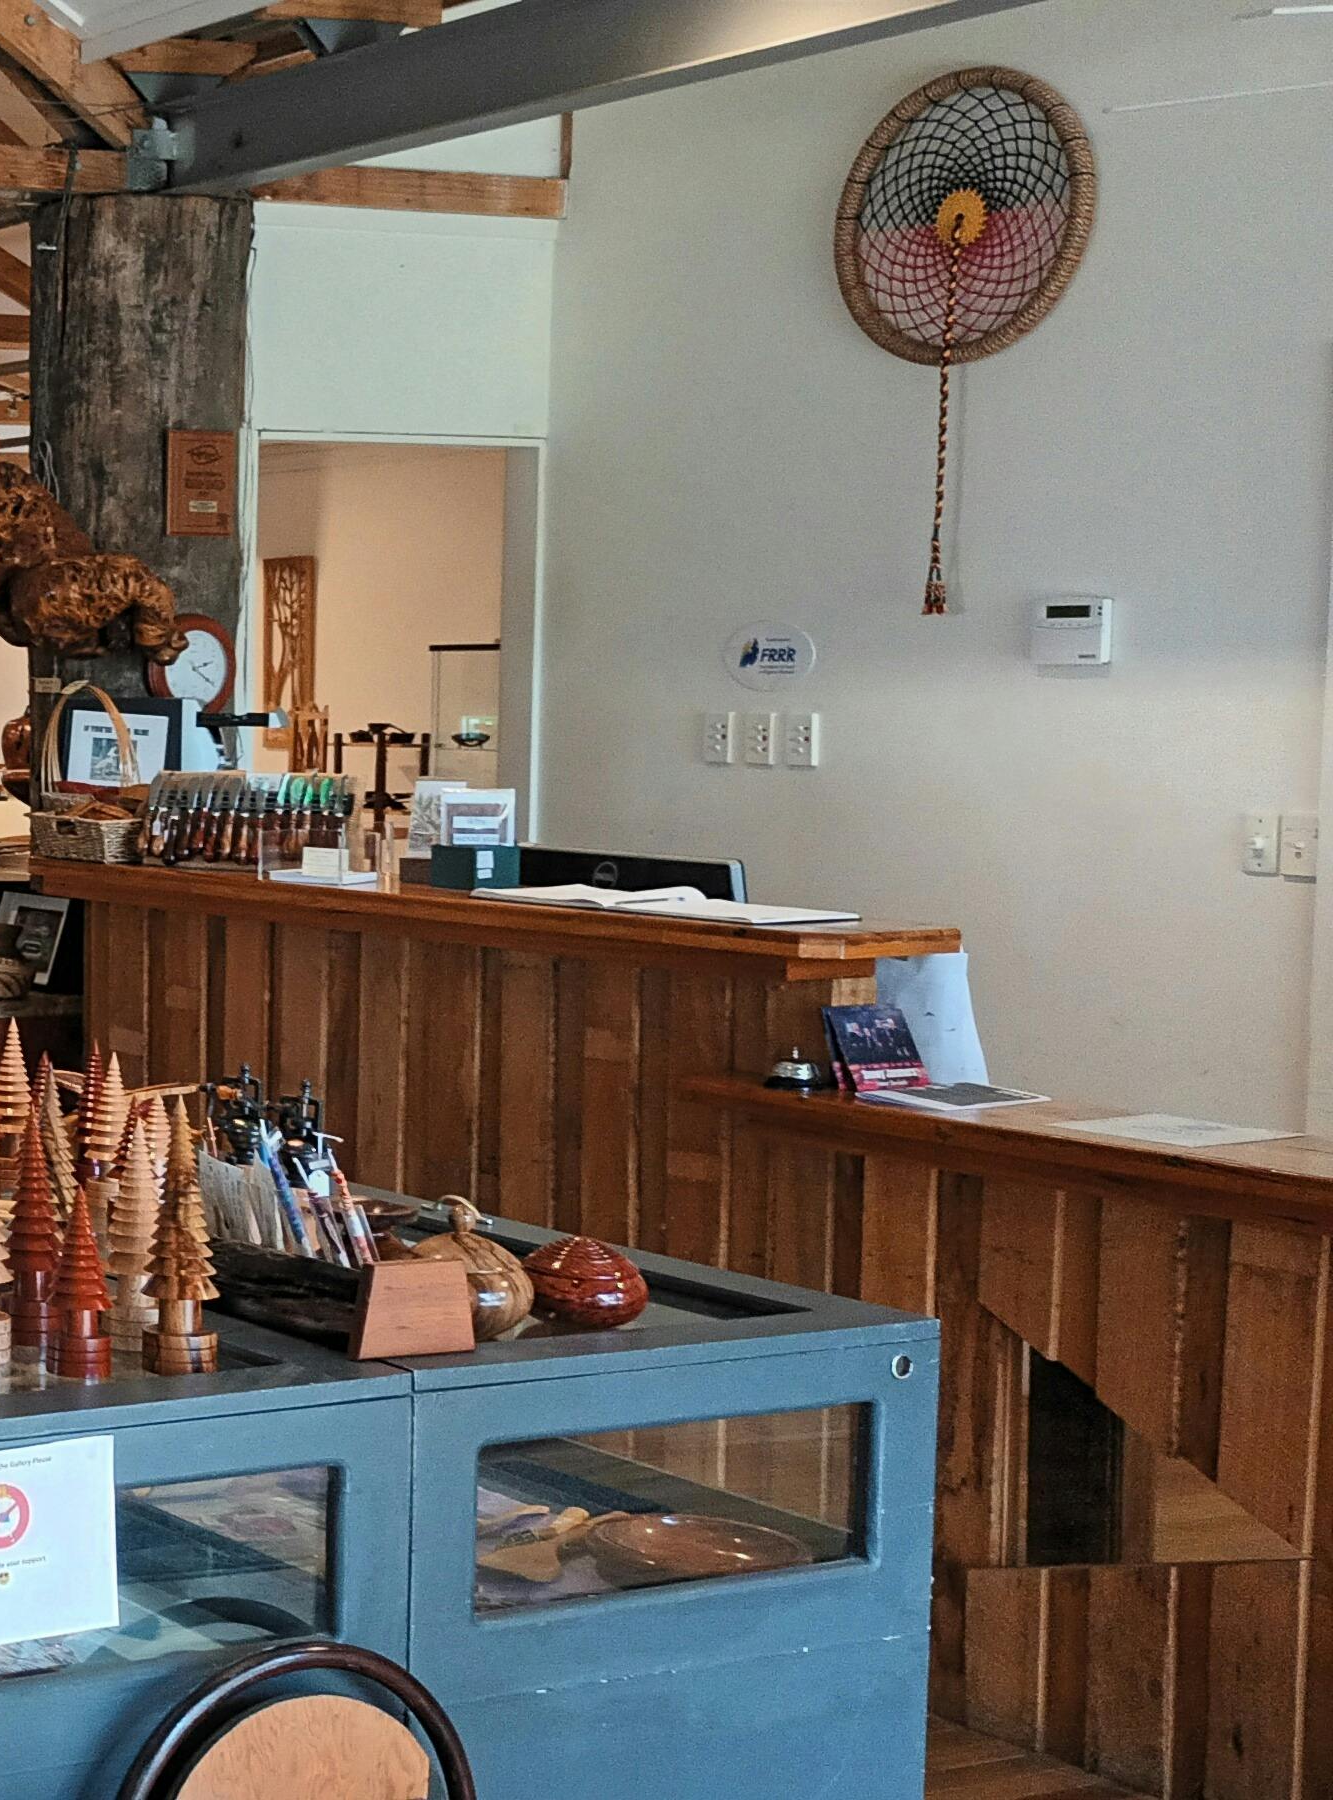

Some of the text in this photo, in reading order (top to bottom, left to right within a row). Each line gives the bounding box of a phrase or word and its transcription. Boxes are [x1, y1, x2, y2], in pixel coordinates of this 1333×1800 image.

[760, 647, 796, 662] FRRR
[10, 1460, 31, 1468] Gallery
[32, 1456, 52, 1464] Please
[6, 1559, 21, 1567] your
[21, 1556, 46, 1565] support
